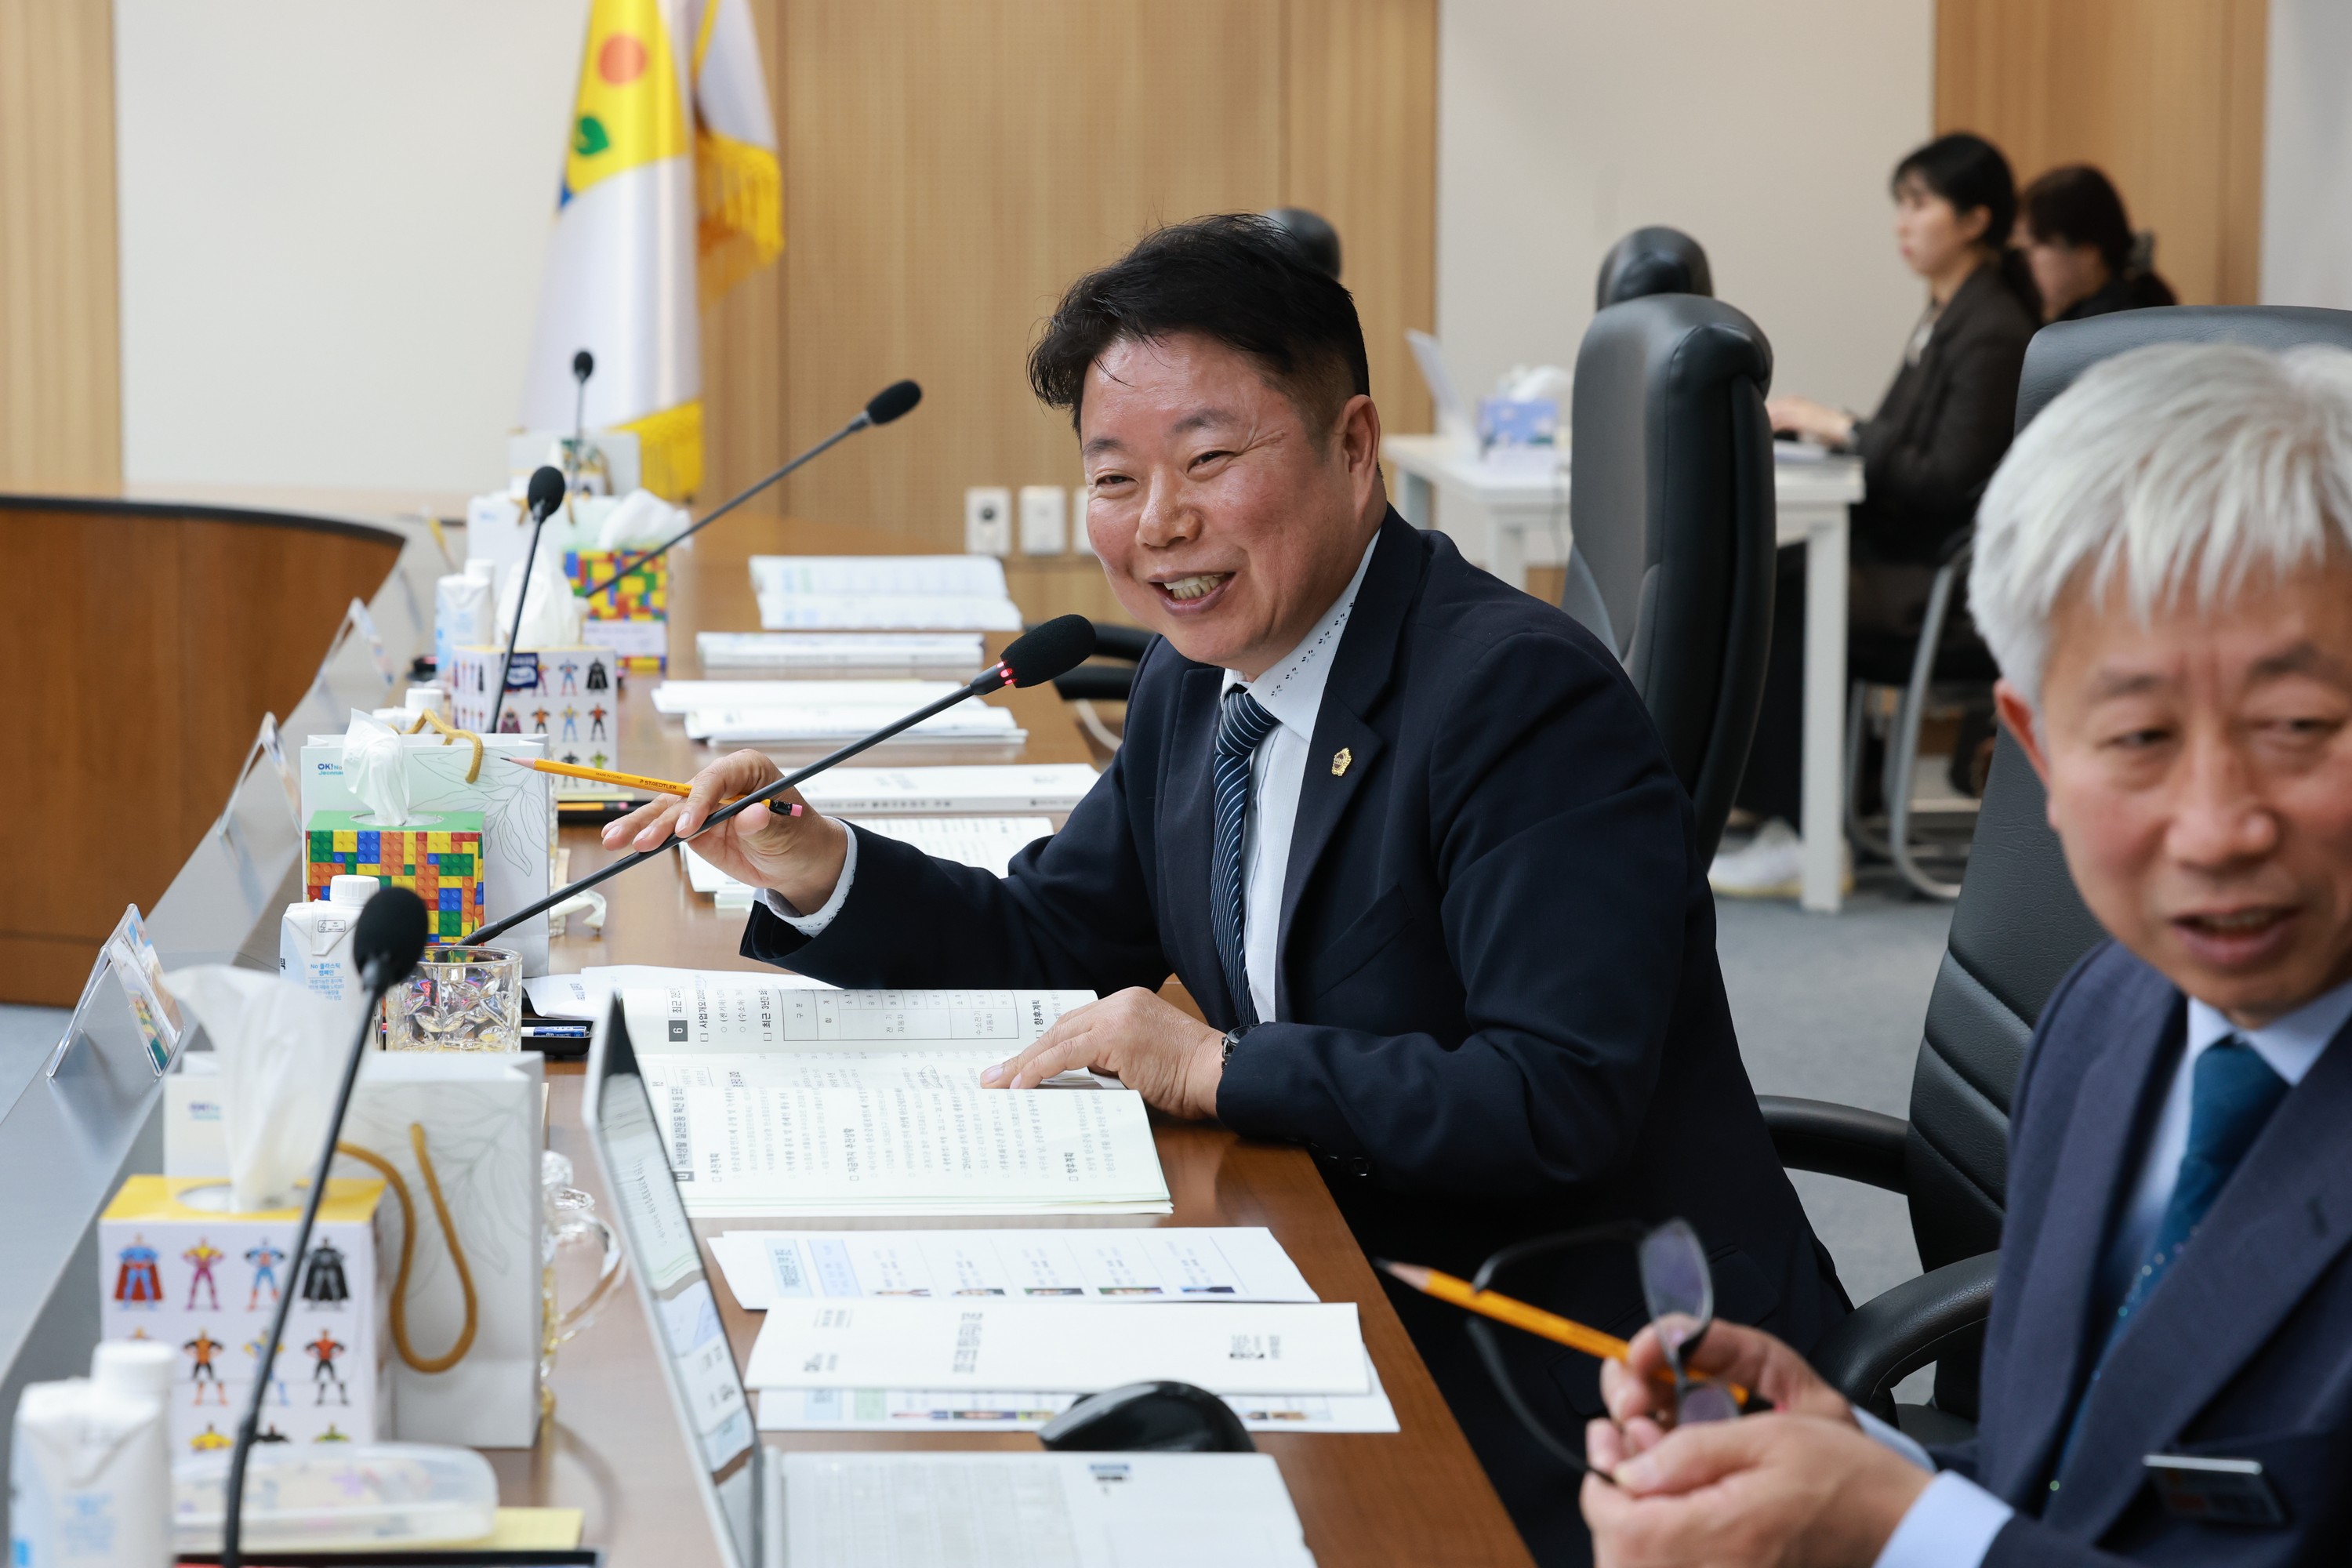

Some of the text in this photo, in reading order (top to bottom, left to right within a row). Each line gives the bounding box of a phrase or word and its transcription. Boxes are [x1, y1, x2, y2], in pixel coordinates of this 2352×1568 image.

[644, 780, 677, 789] STAEDTLER
[671, 1001, 682, 1014] 최근
[718, 1000, 728, 1022] (전기차)
[737, 1000, 746, 1022] (수소차)
[760, 996, 770, 1010] 3년간
[1032, 1000, 1044, 1025] 향후계획
[761, 1013, 771, 1029] 최근
[974, 1011, 982, 1036] 수소전기
[985, 1013, 994, 1033] 자동차
[673, 1102, 684, 1113] 확산
[674, 1116, 687, 1138] 실천운동
[676, 1142, 688, 1166] 녹색생활
[844, 1128, 858, 1173] 지금까지 추진상황
[710, 1153, 721, 1174] 추진계획
[1065, 1152, 1078, 1174] 향후계획
